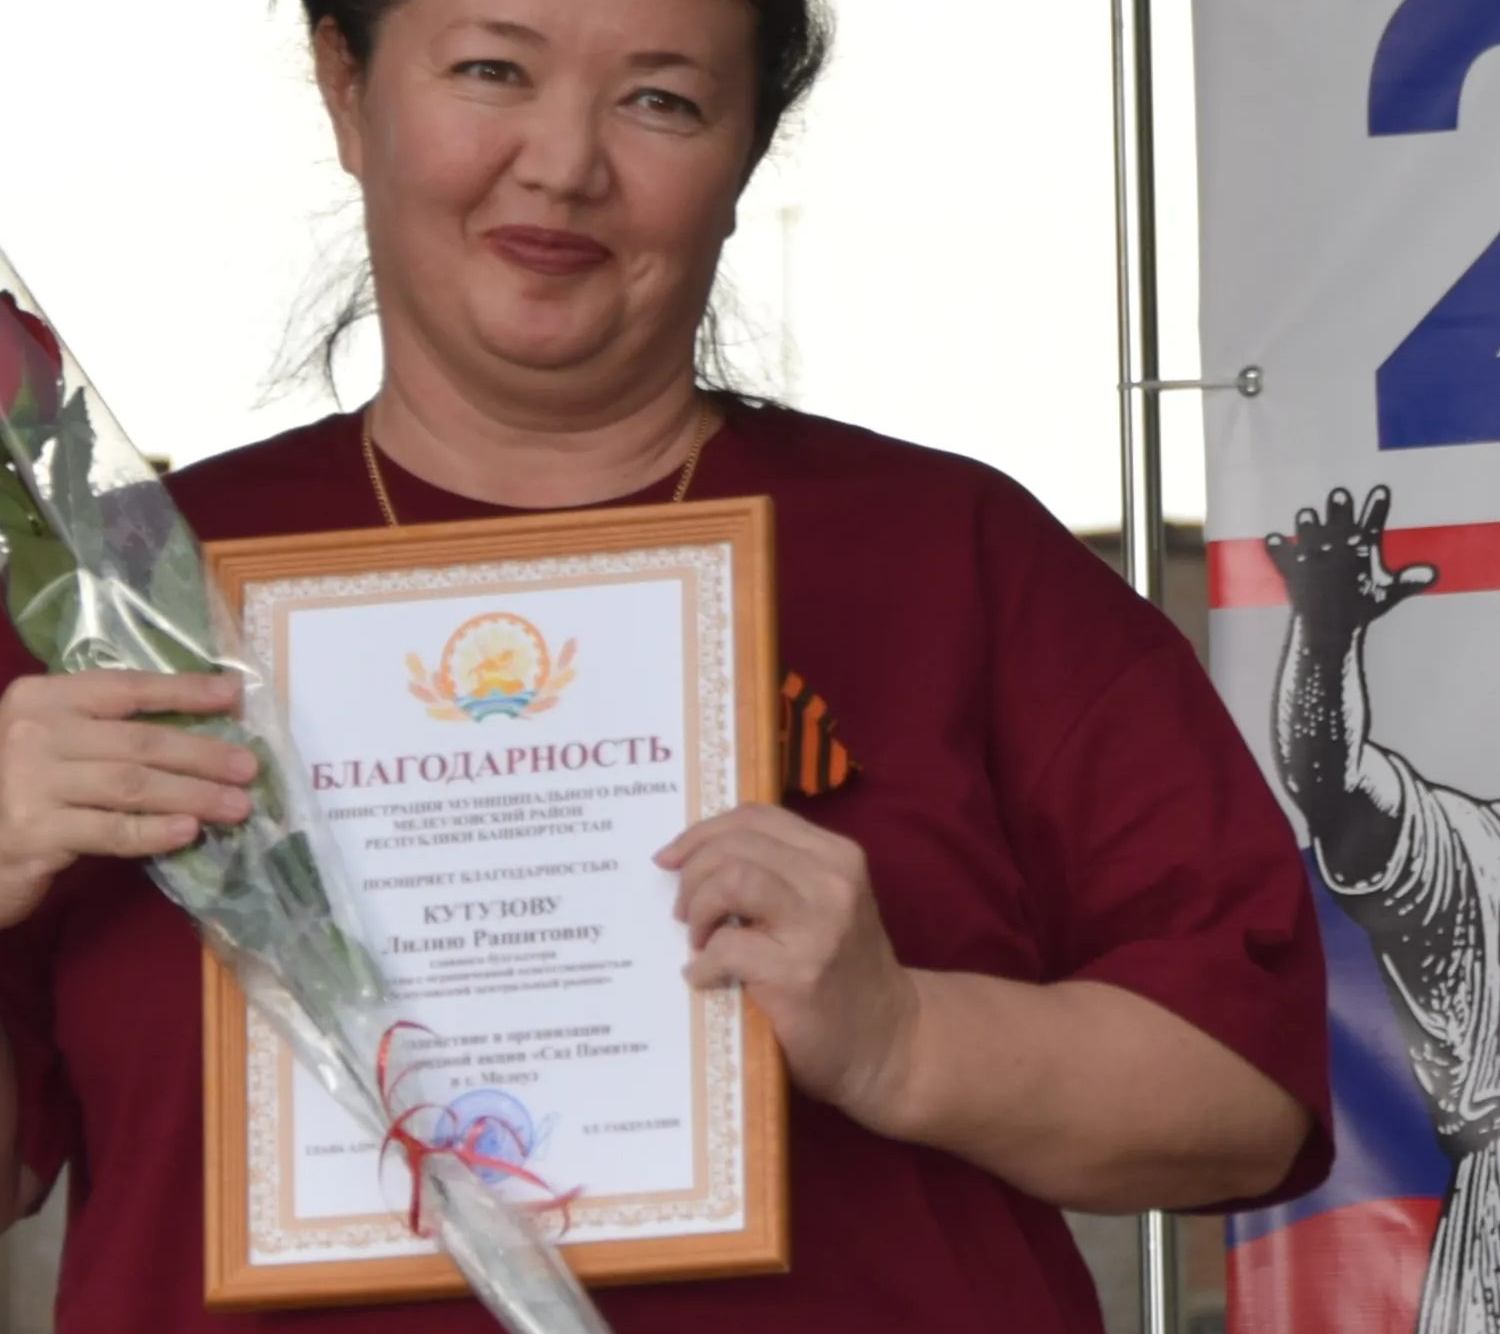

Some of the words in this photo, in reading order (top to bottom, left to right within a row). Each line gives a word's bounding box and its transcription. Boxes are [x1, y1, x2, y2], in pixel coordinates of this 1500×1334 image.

[310, 735, 672, 791] БЛАГОДАРНОСТЬ
[613, 779, 679, 798] РАЙОНА
[529, 805, 584, 821] РАЙОН
[365, 831, 473, 850] РЕСПУБЛИКИ
[477, 819, 613, 842] БАШКОРТОСТАН
[422, 895, 562, 925] КУТУЗОВУ
[381, 936, 466, 955] Лилию
